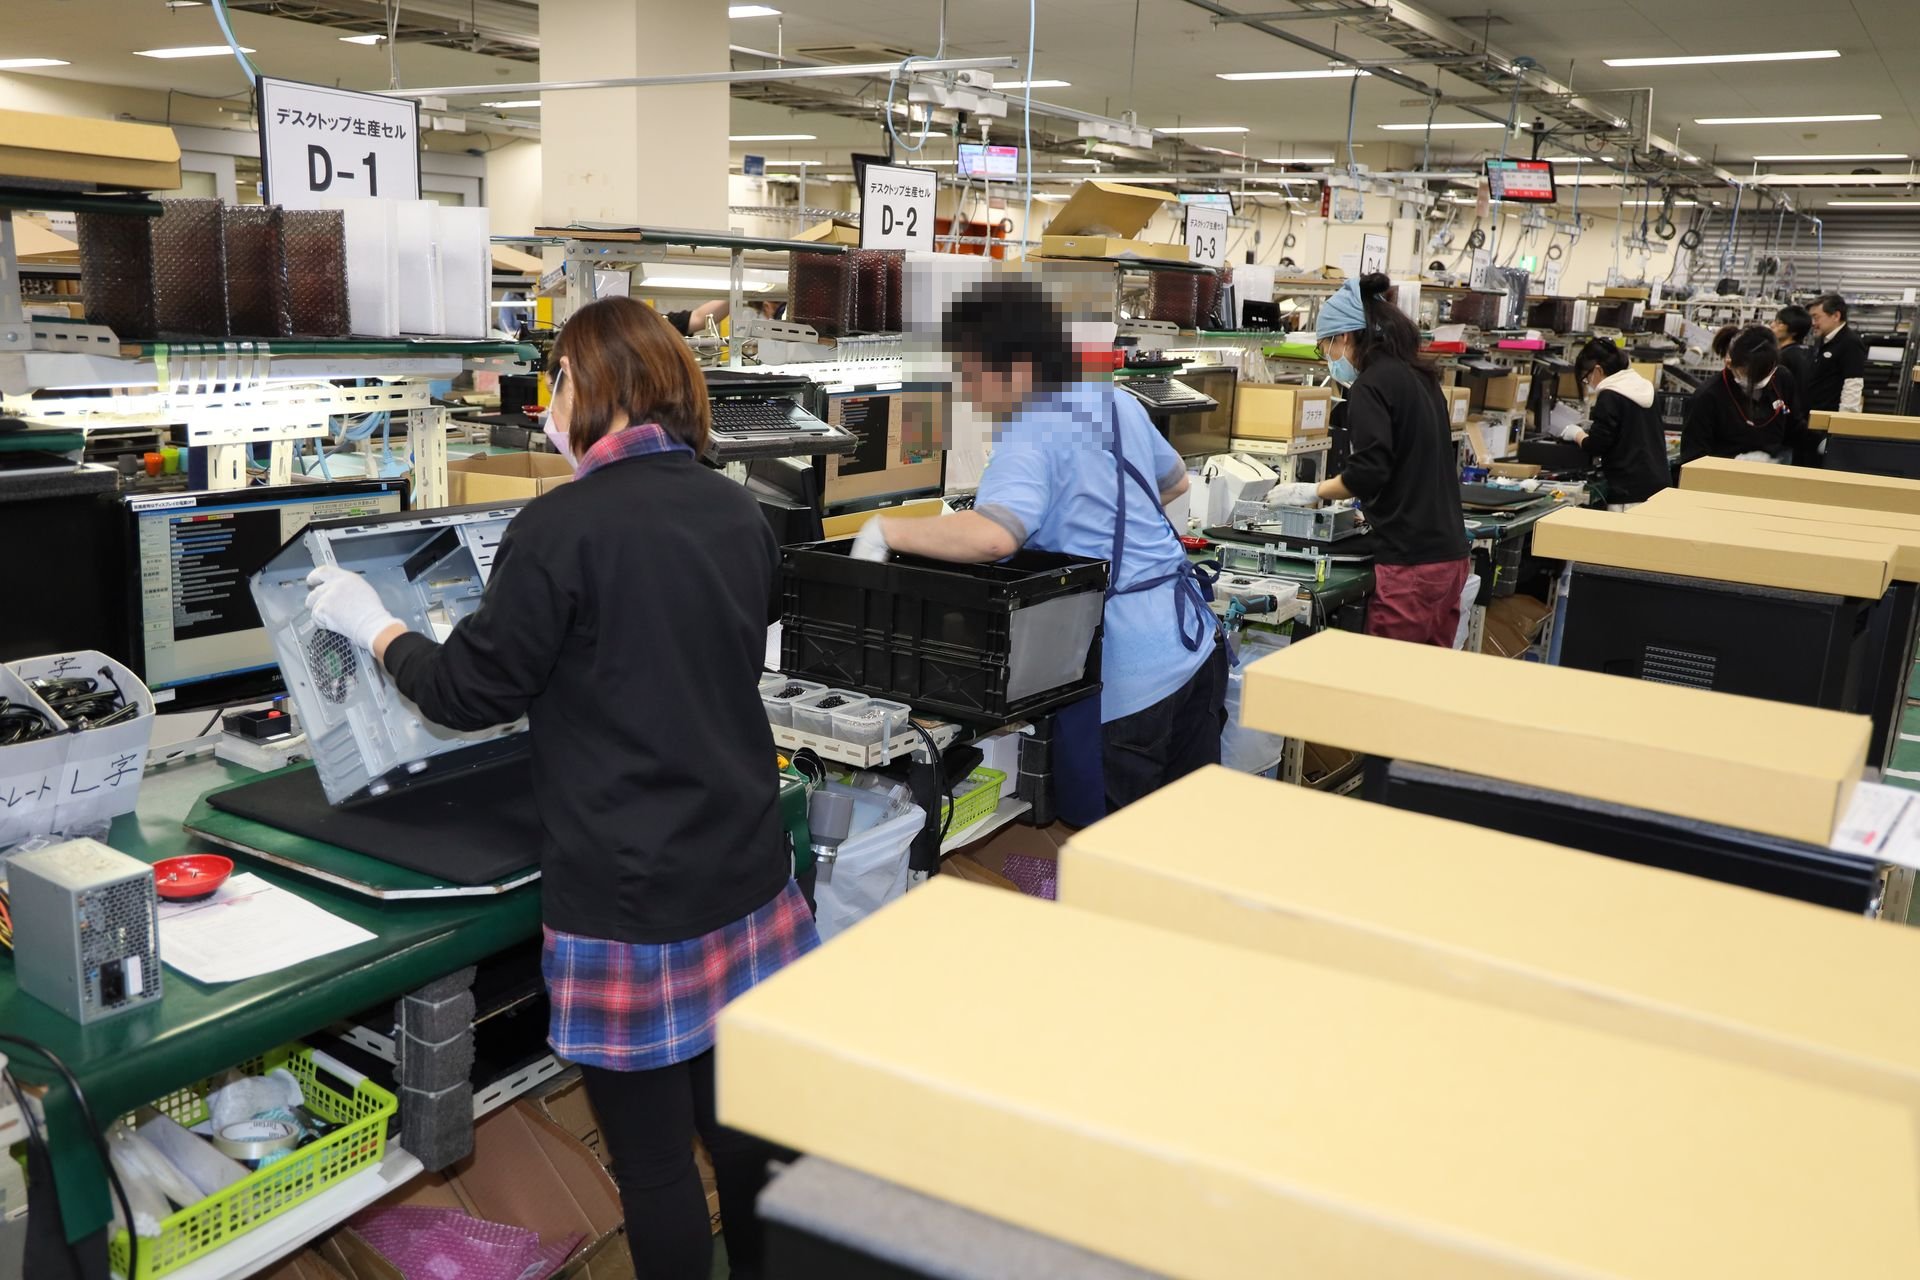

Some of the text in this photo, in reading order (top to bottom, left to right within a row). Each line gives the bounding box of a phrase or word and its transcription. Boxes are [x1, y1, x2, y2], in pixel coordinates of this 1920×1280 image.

[277, 107, 407, 140] デスクトップ生産セル
[308, 144, 378, 197] D-1
[871, 183, 931, 198] デスクトップ生産セル
[881, 204, 918, 237] D-2
[1195, 235, 1216, 260] D-3
